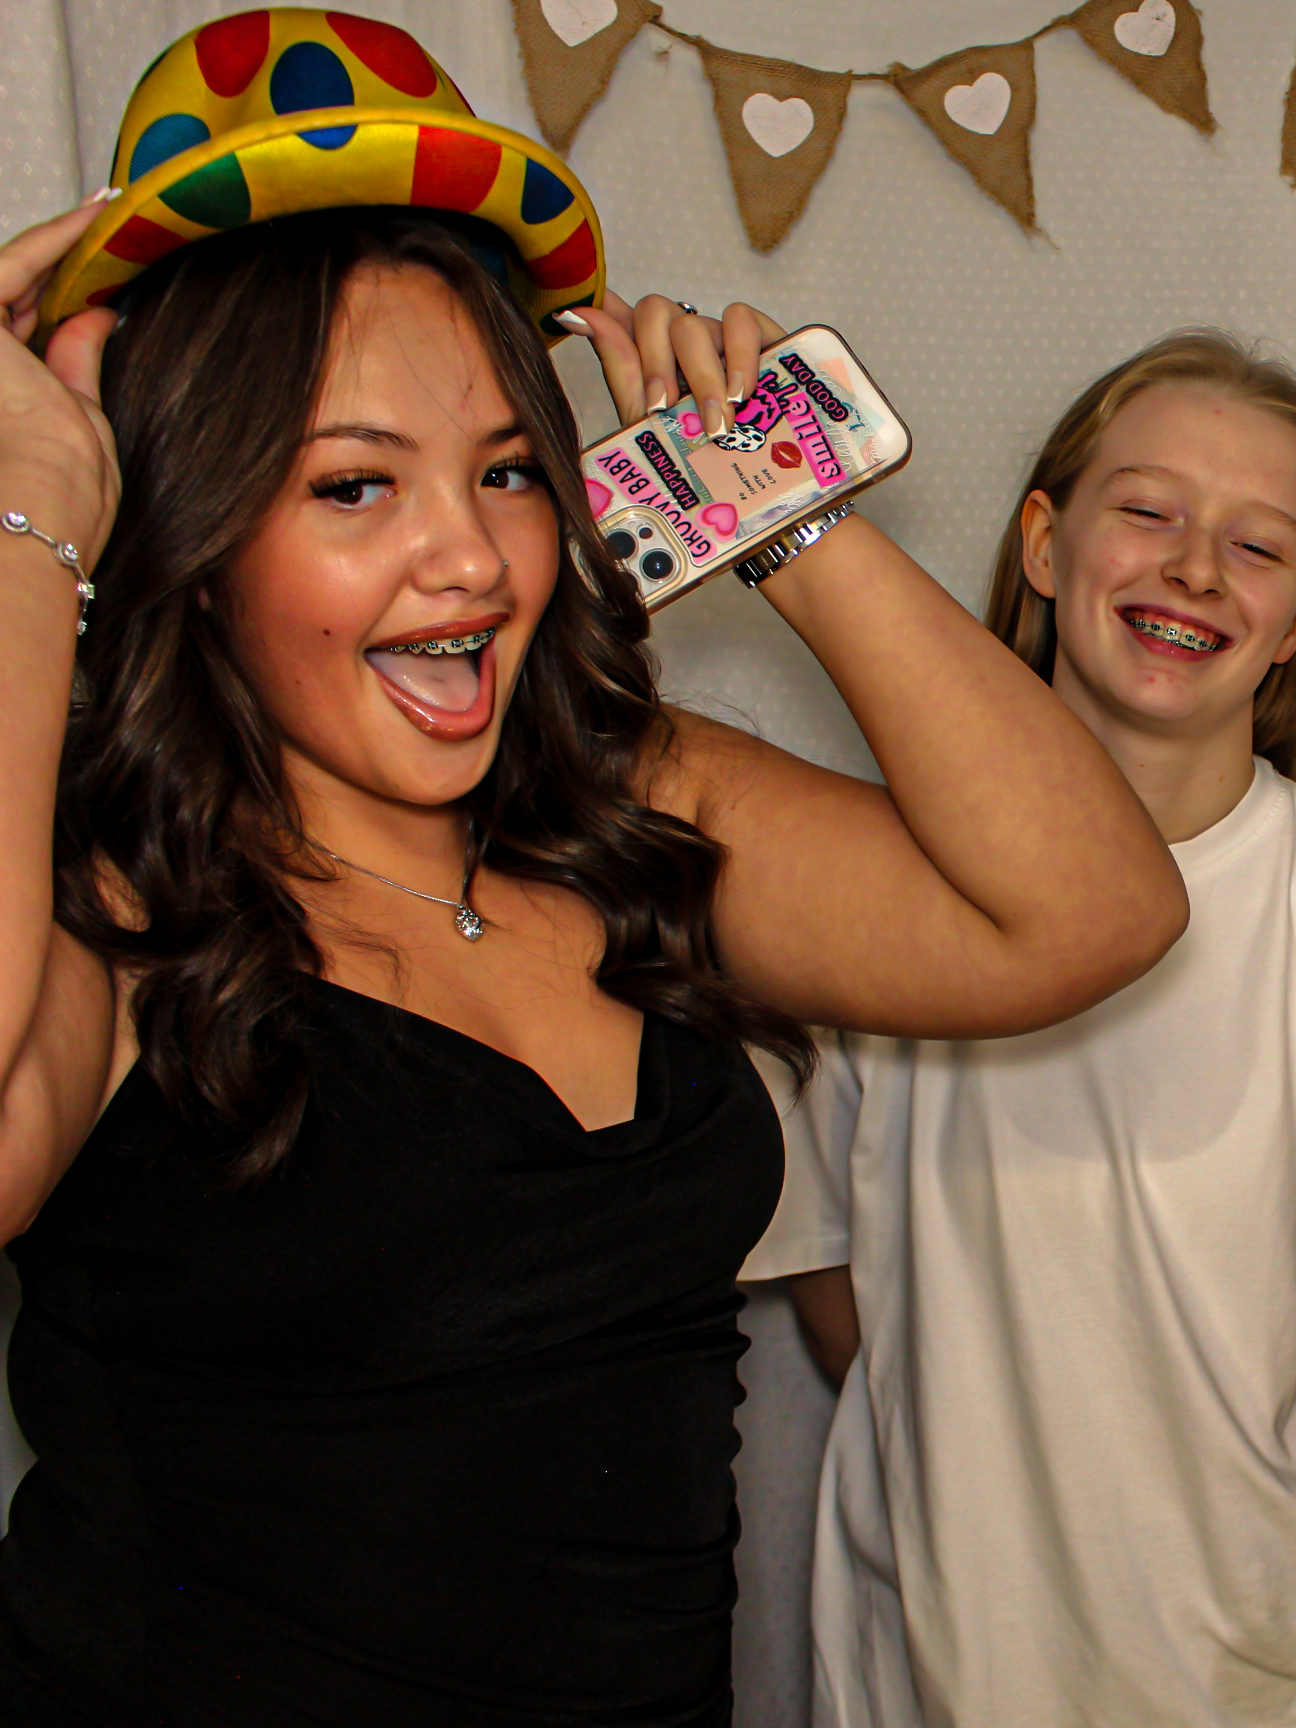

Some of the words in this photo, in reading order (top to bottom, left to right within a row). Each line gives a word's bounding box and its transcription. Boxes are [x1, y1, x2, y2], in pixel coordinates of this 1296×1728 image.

[782, 355, 812, 382] DAY
[809, 381, 844, 419] GOOD
[787, 400, 840, 481] smile
[597, 450, 650, 495] BABY
[638, 433, 696, 508] HAPPINESS
[731, 463, 757, 496] SOMETHING
[752, 474, 766, 490] WITH
[761, 468, 777, 485] LOVE
